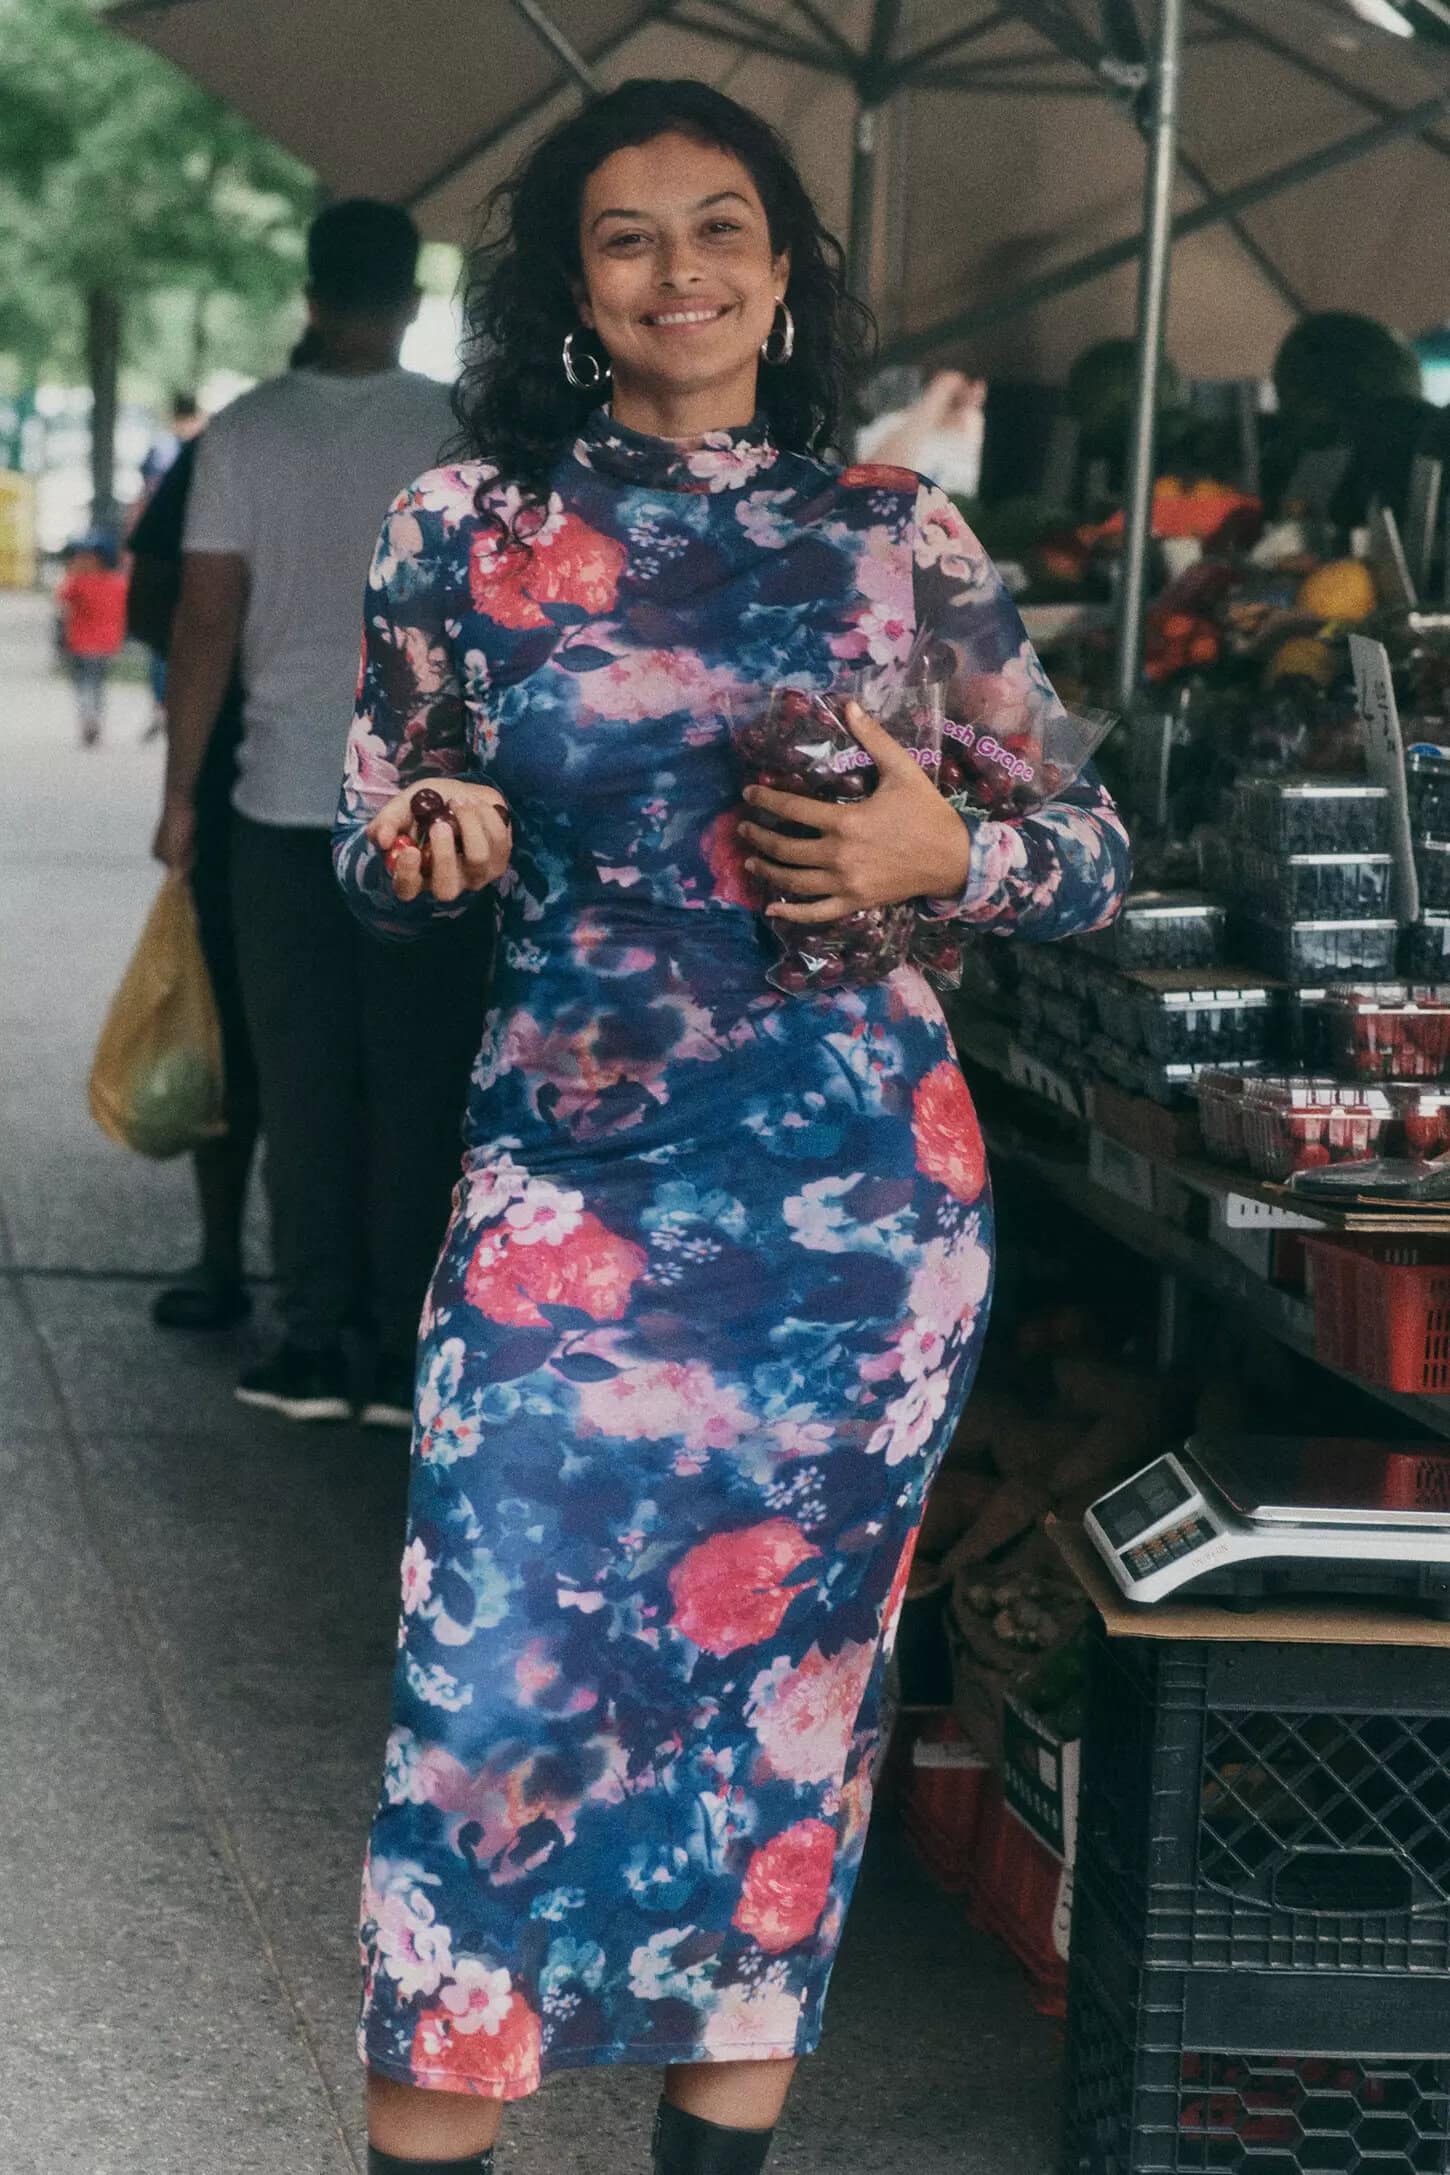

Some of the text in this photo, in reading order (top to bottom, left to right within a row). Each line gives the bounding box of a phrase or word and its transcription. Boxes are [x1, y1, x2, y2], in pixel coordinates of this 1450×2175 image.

[833, 748, 875, 773] Fre
[943, 719, 1034, 782] esh Grape
